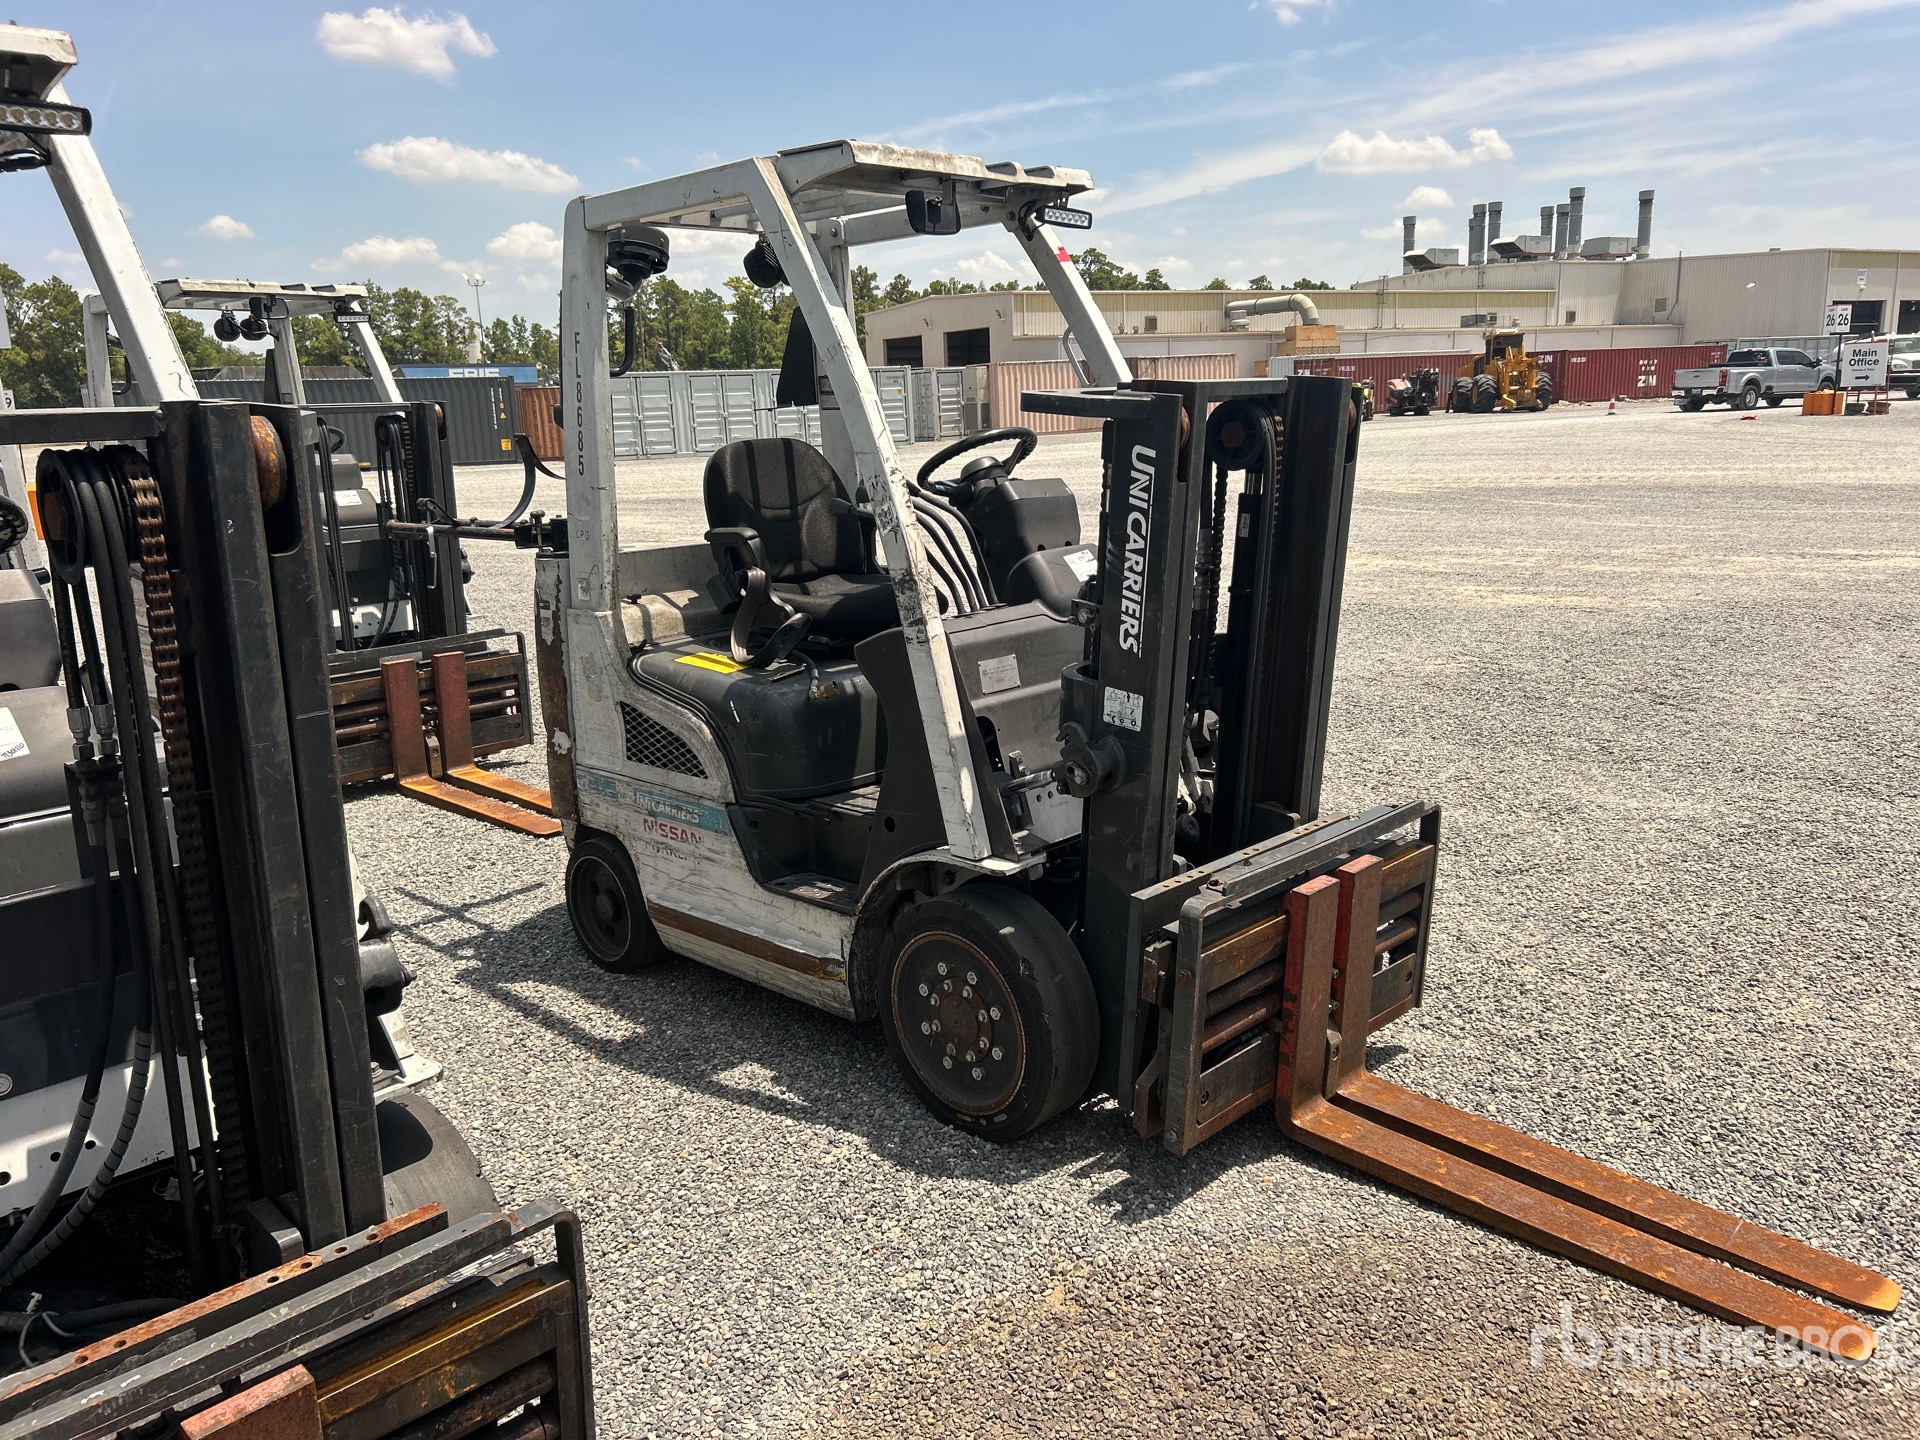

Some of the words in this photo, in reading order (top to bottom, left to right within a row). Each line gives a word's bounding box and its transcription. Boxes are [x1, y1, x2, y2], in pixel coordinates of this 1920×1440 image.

[1826, 313, 1836, 326] 26
[1837, 313, 1850, 326] 26
[1852, 348, 1878, 358] Main
[1848, 358, 1880, 367] Office
[574, 331, 585, 476] FL8685
[576, 530, 590, 540] LPG
[1118, 444, 1157, 656] UNICARRIERS
